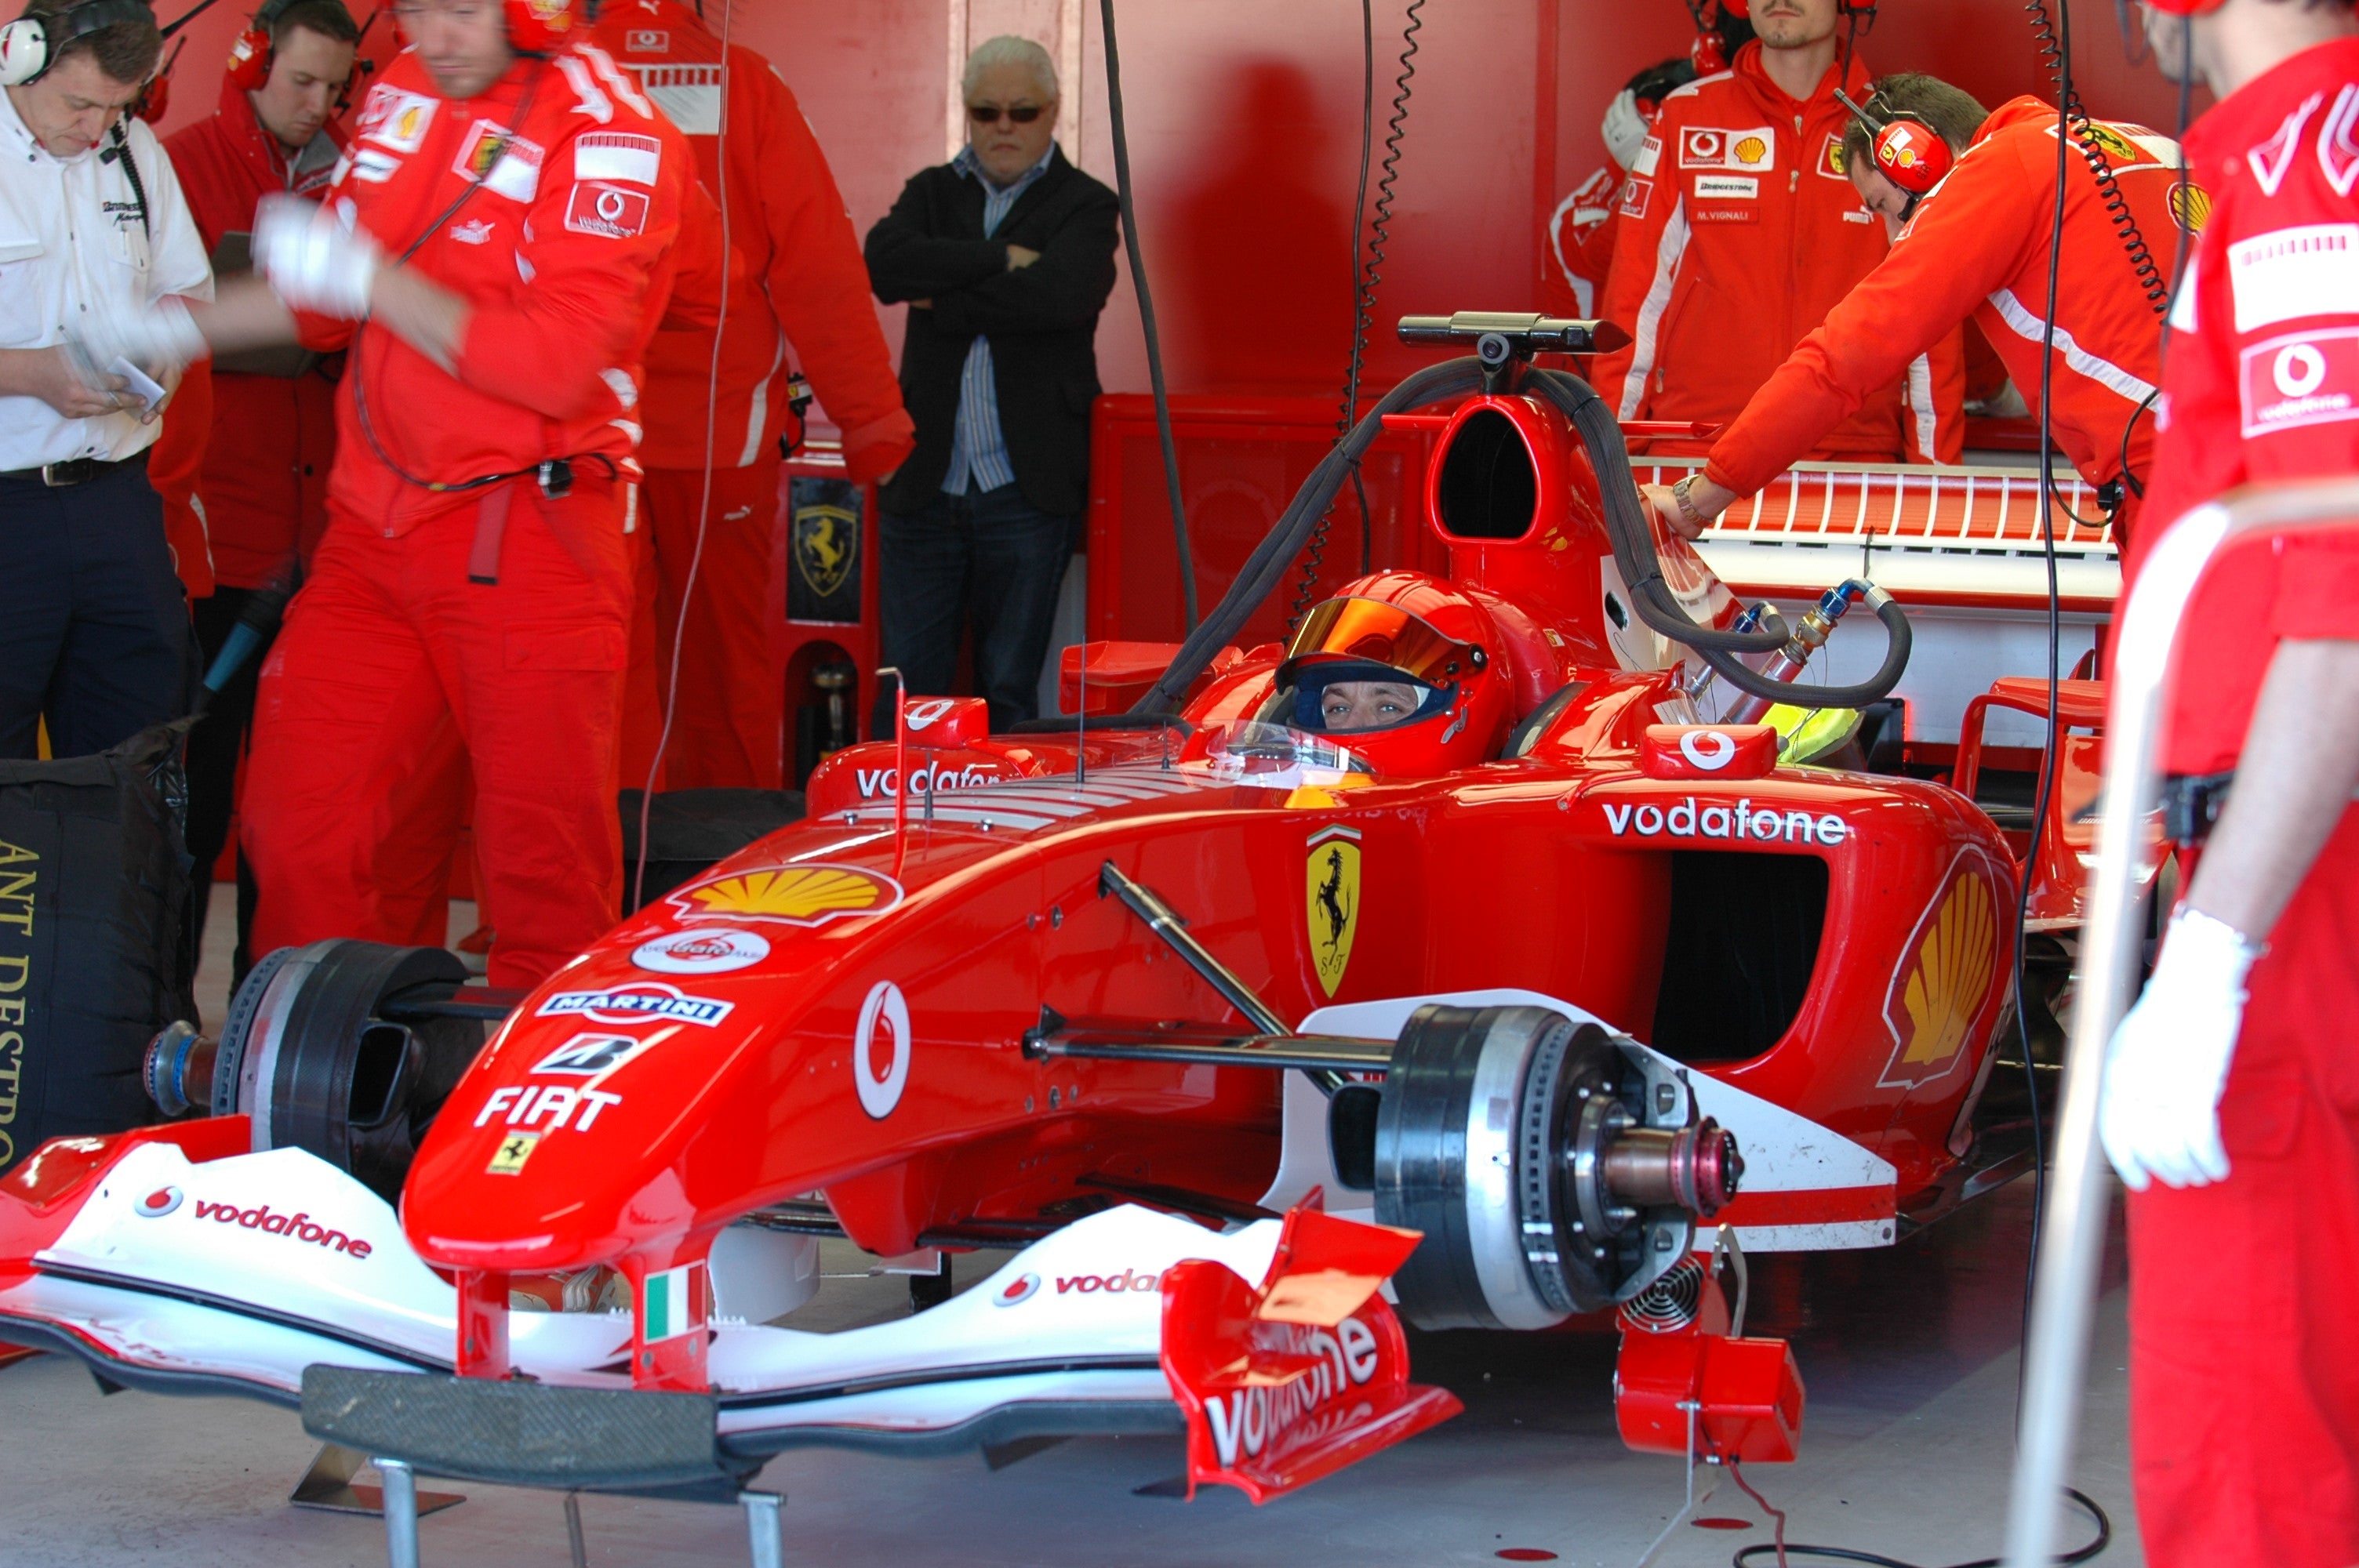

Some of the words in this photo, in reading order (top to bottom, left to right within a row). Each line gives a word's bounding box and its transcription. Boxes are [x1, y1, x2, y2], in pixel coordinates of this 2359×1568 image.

[1697, 212, 1709, 220] M.
[1710, 212, 1749, 220] VIGNALI
[1601, 797, 1845, 845] vodafone
[557, 996, 718, 1018] MARTINI
[473, 1085, 623, 1132] FIAT
[195, 1200, 373, 1260] vodafone
